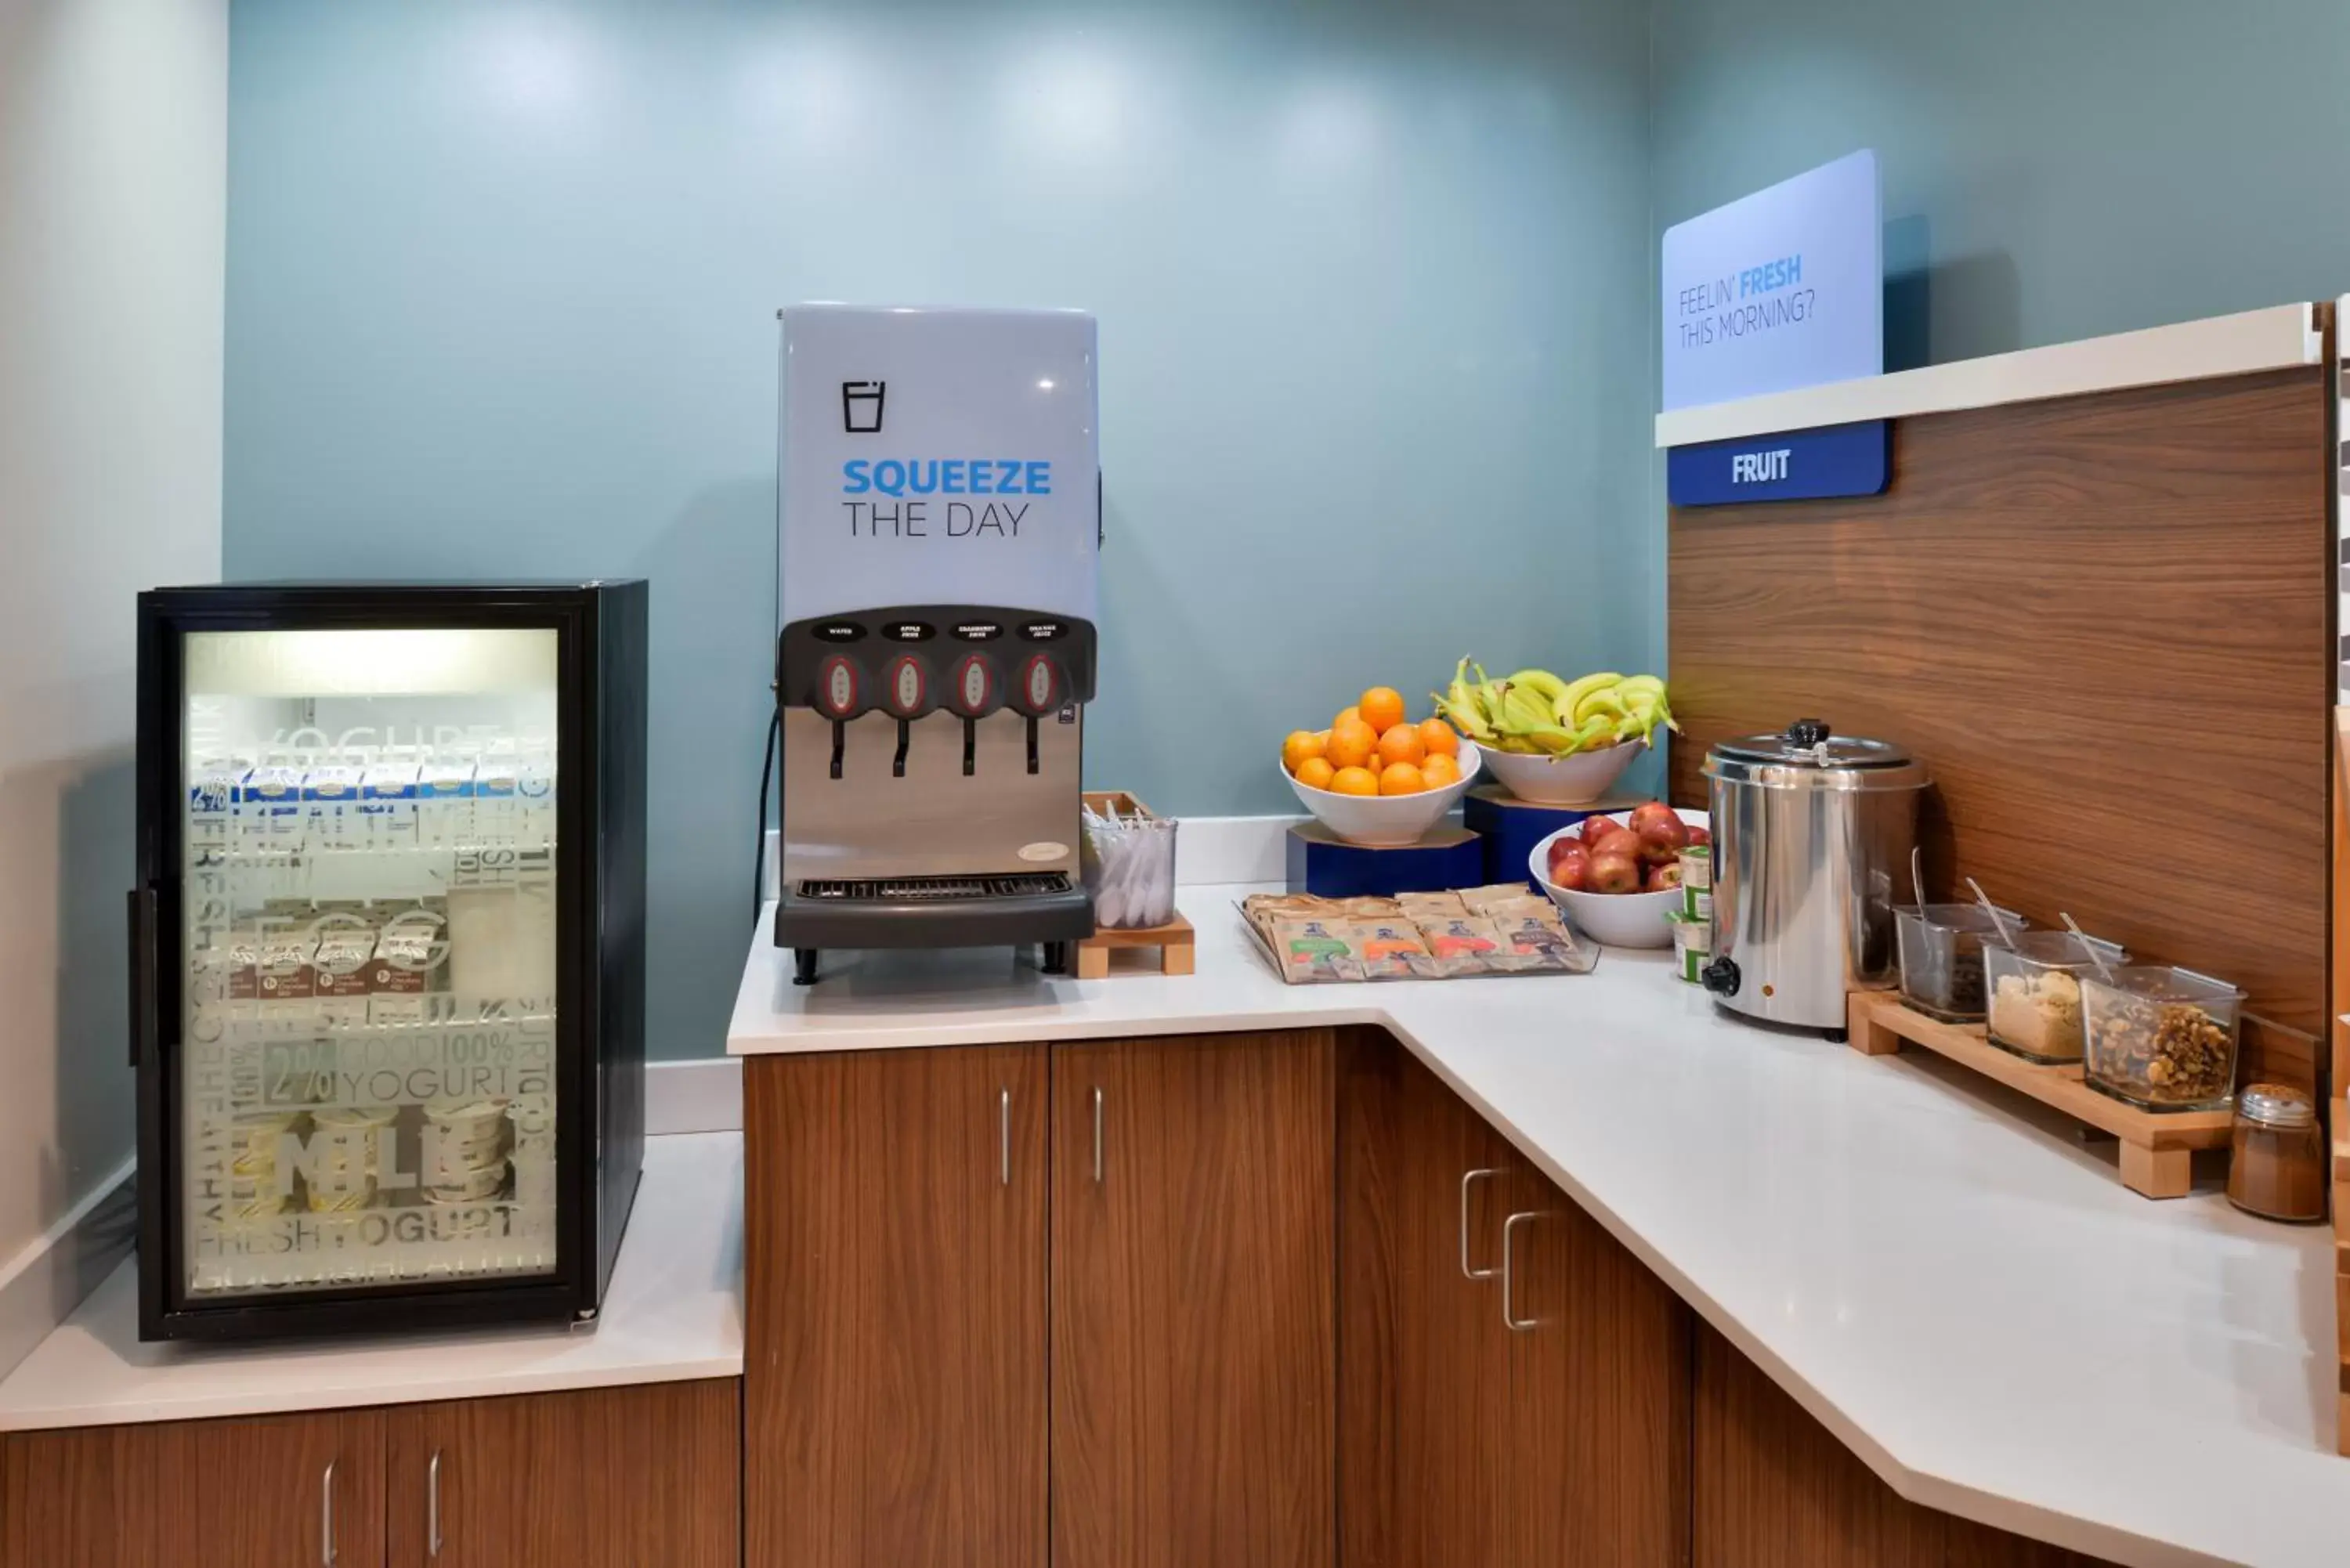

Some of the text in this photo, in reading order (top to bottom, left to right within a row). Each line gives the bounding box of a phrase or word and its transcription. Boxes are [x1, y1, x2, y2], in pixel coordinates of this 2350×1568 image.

[1679, 254, 1802, 316] FEELIN' FRESH
[1679, 288, 1815, 349] THIS MORNING?
[842, 459, 1051, 497] SQUEEZE
[1732, 448, 1792, 484] FRUIT
[841, 501, 1029, 537] THE DAY
[442, 1029, 514, 1067] 100%
[342, 1066, 509, 1103] YOGURT
